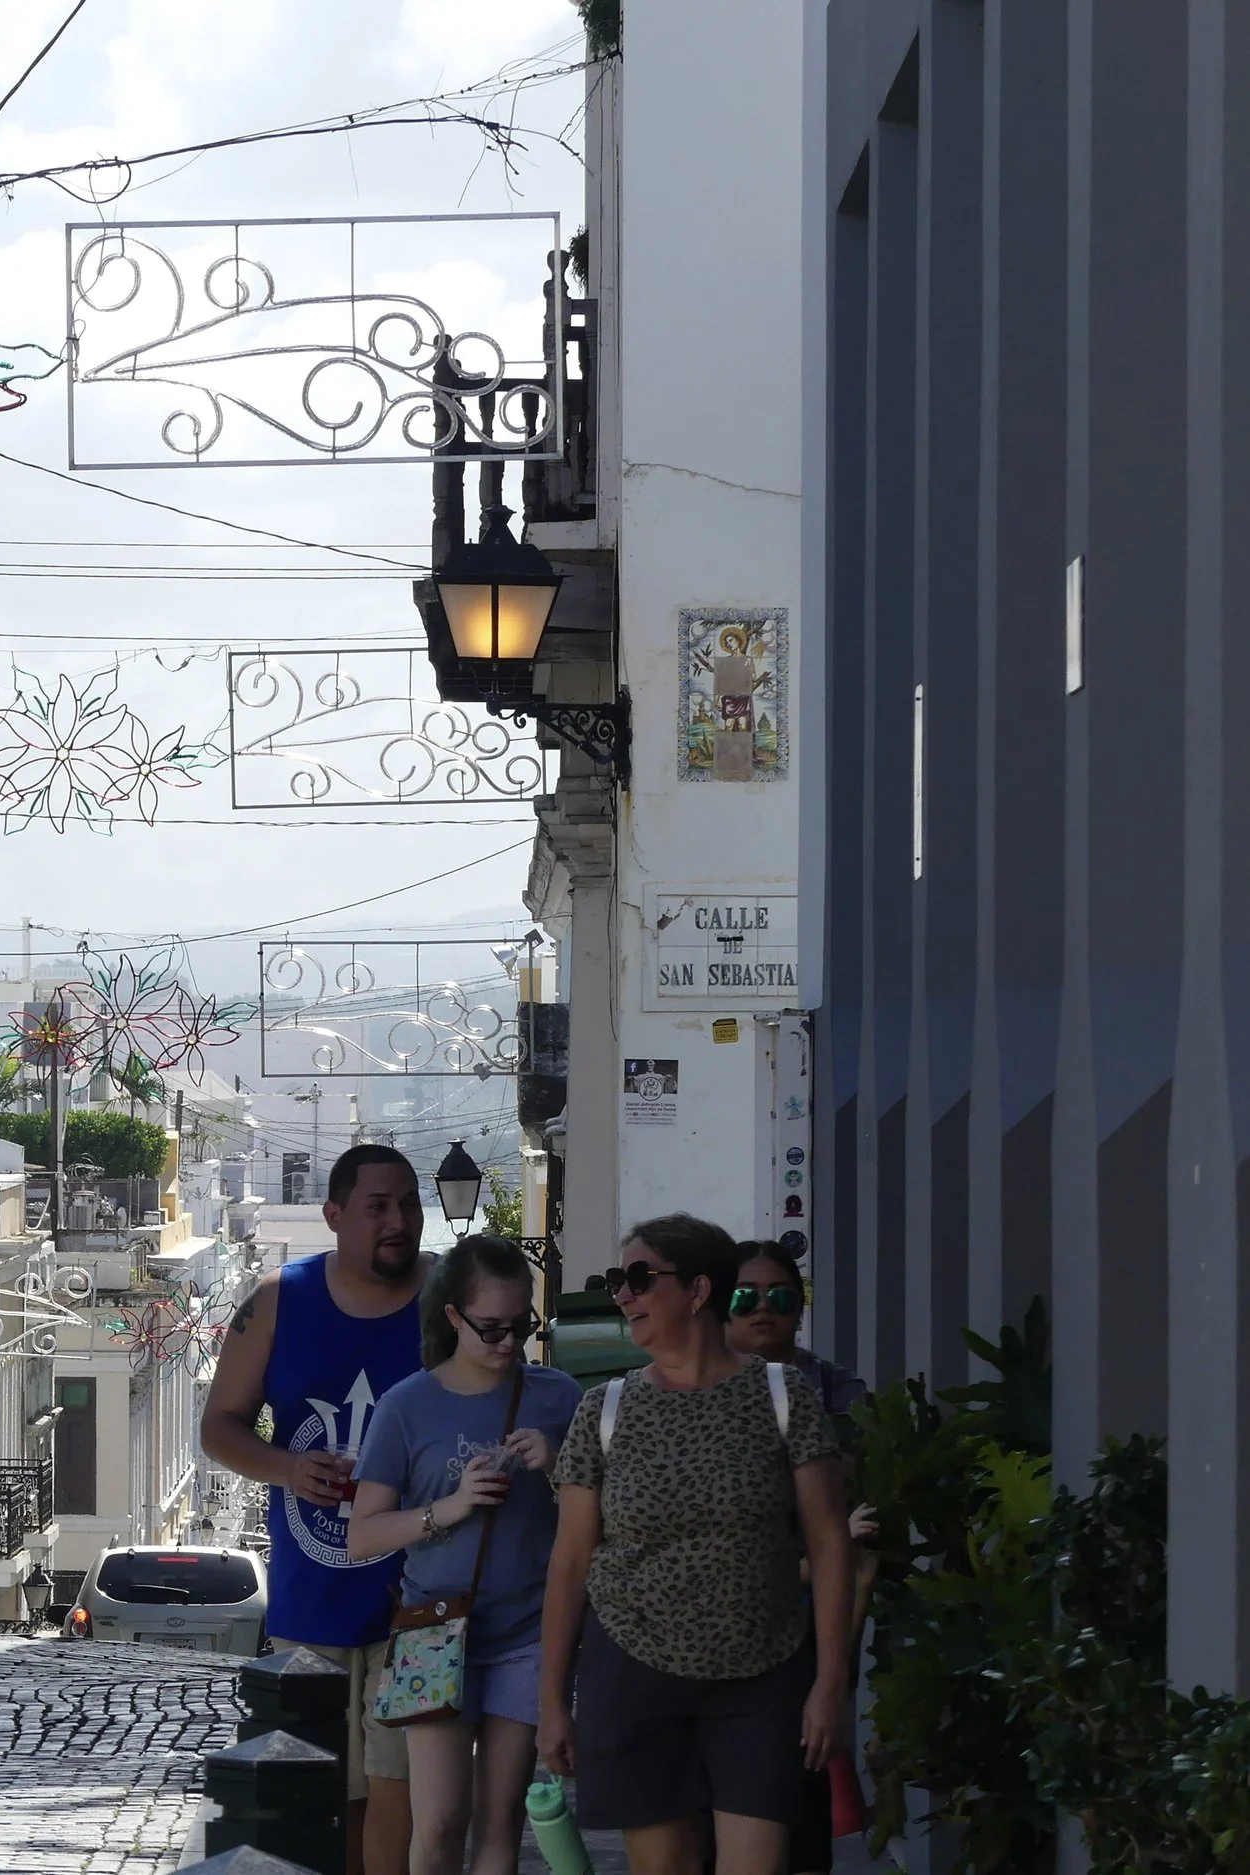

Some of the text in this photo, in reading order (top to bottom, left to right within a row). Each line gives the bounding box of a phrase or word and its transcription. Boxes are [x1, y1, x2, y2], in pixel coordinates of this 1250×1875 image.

[695, 907, 769, 930] CALLE
[722, 938, 743, 954] DE
[659, 963, 798, 987] SAN SEBASTIA
[312, 1509, 346, 1536] POSEI
